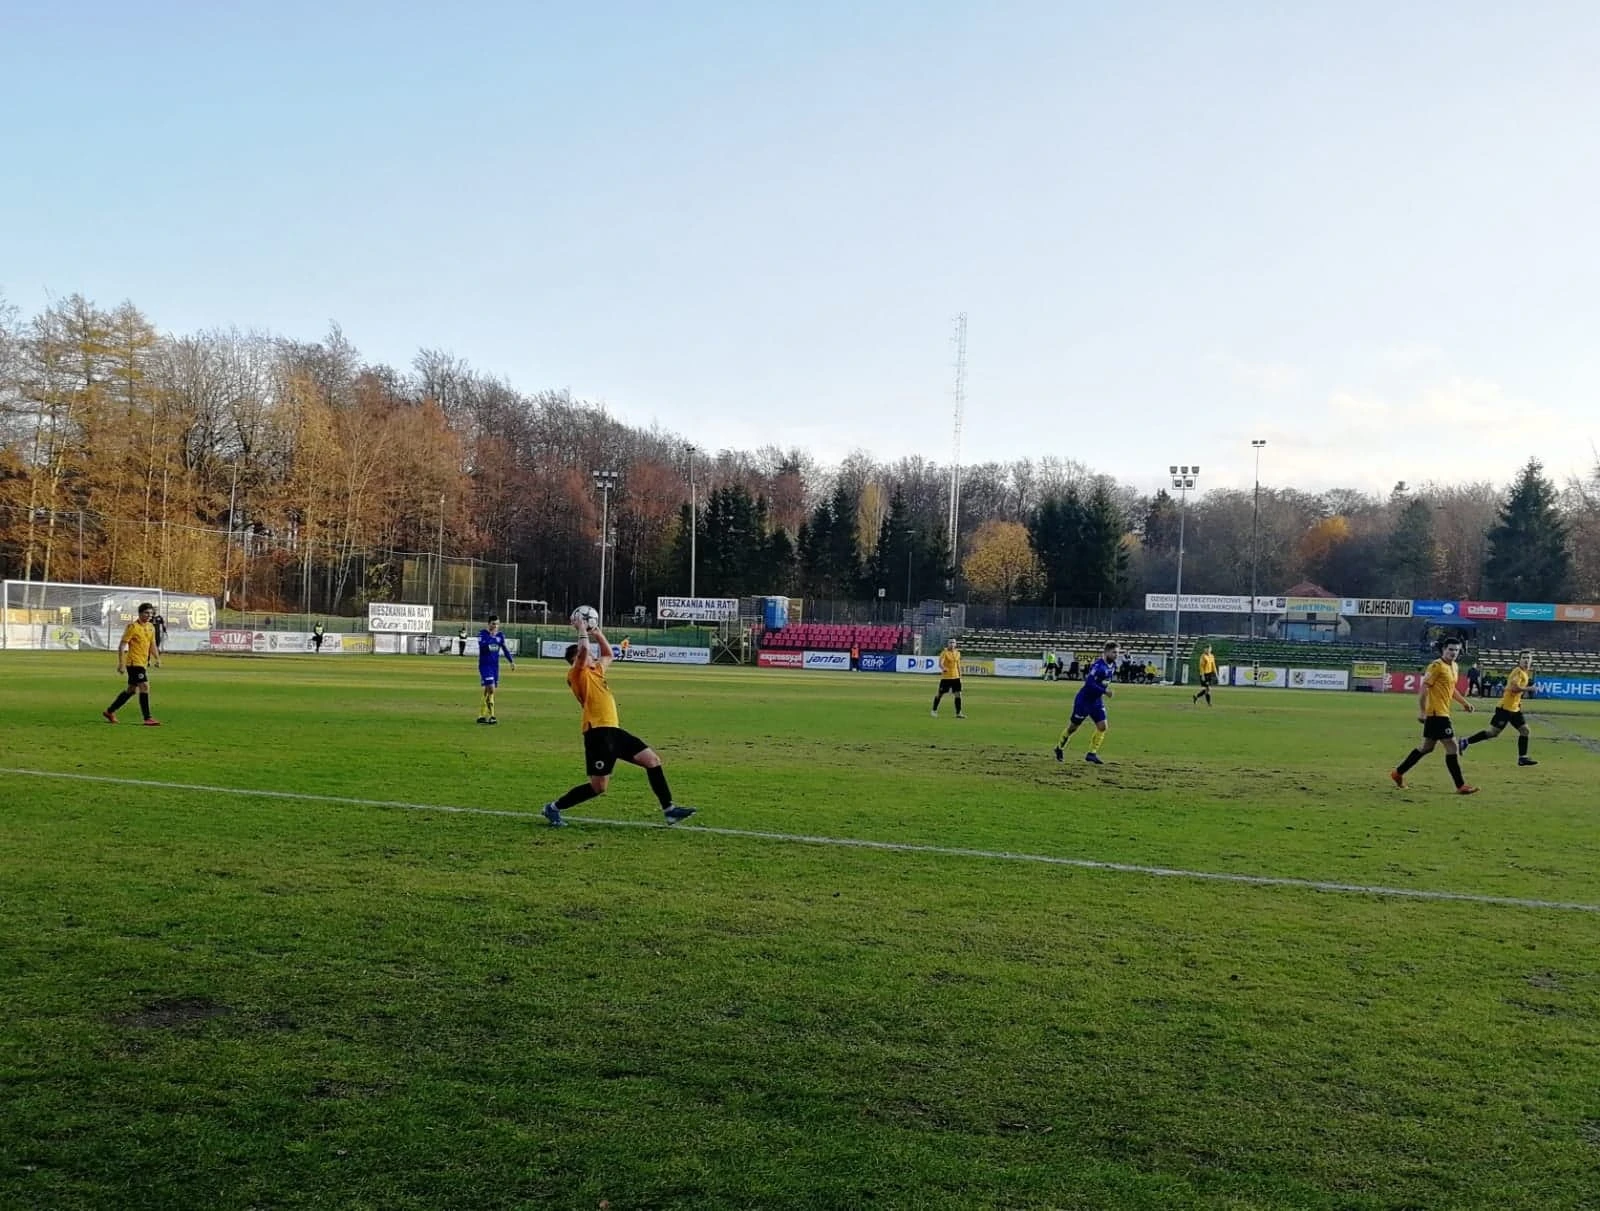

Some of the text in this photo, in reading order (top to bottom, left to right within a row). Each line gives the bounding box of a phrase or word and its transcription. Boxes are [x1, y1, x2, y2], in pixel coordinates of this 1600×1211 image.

[660, 599, 736, 609] MIESZKANIA NA RATY
[1359, 600, 1410, 616] WEJHEROWO
[407, 607, 416, 617] NA
[806, 653, 847, 664] jantar
[1403, 674, 1416, 690] 2
